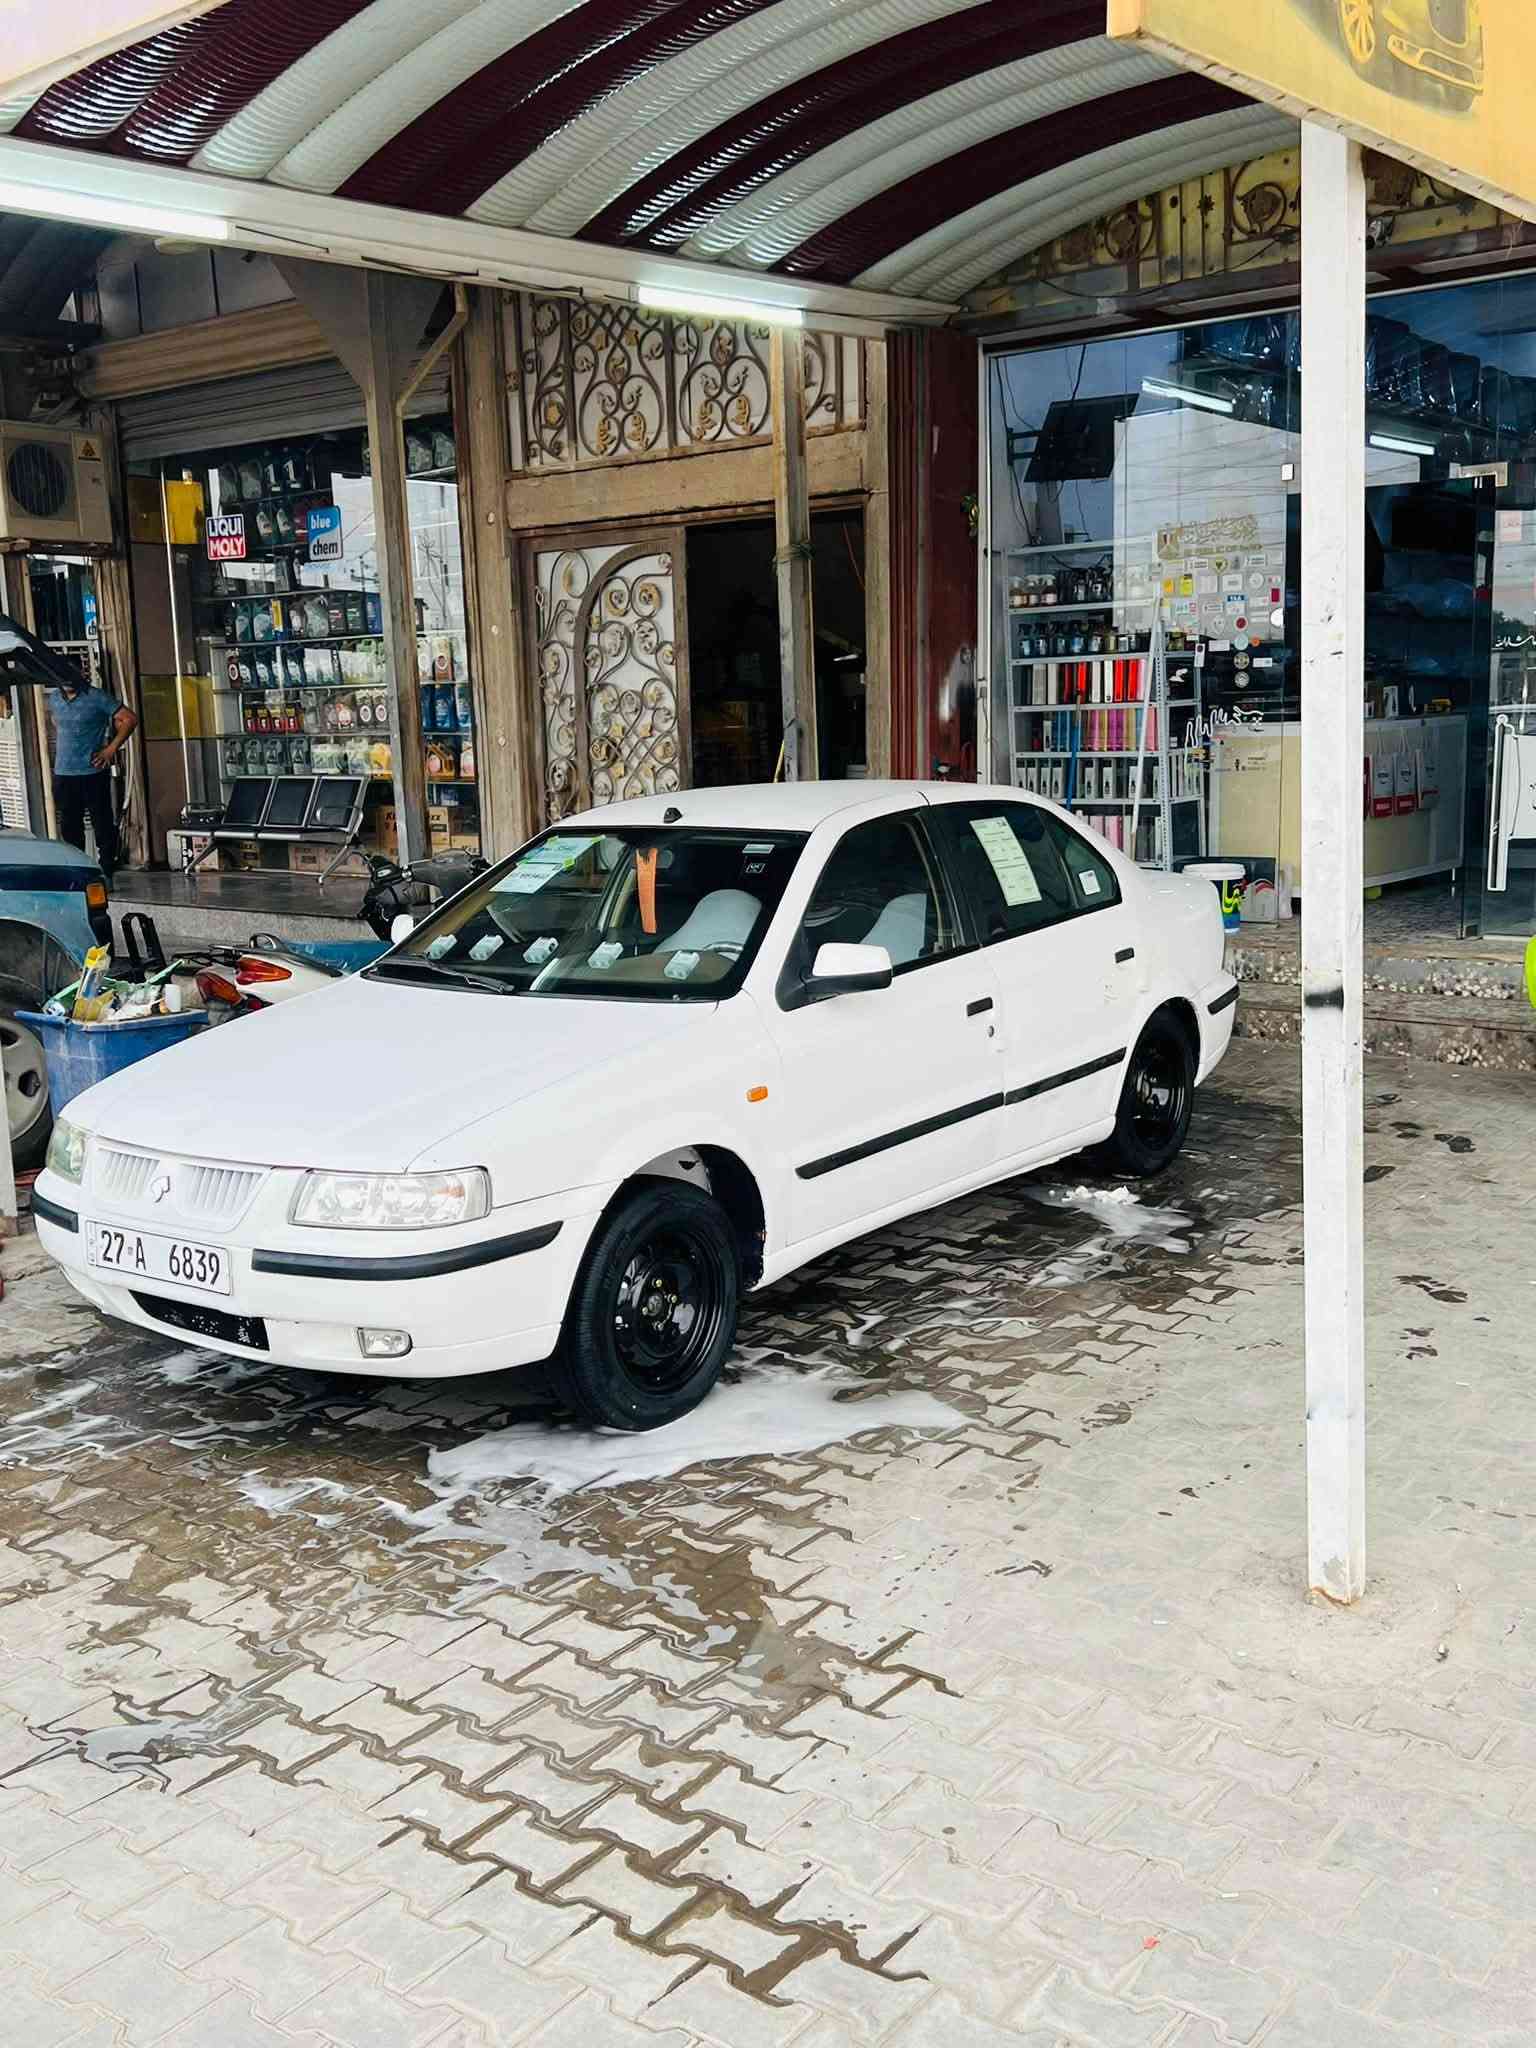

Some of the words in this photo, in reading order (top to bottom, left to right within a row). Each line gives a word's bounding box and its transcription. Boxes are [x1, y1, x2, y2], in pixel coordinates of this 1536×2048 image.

[209, 517, 242, 537] LIQUI
[311, 514, 331, 529] blue
[210, 537, 243, 557] MOLY
[313, 539, 338, 556] chem
[101, 1230, 125, 1264] 27
[136, 1236, 146, 1271] A
[169, 1244, 220, 1286] 6839
